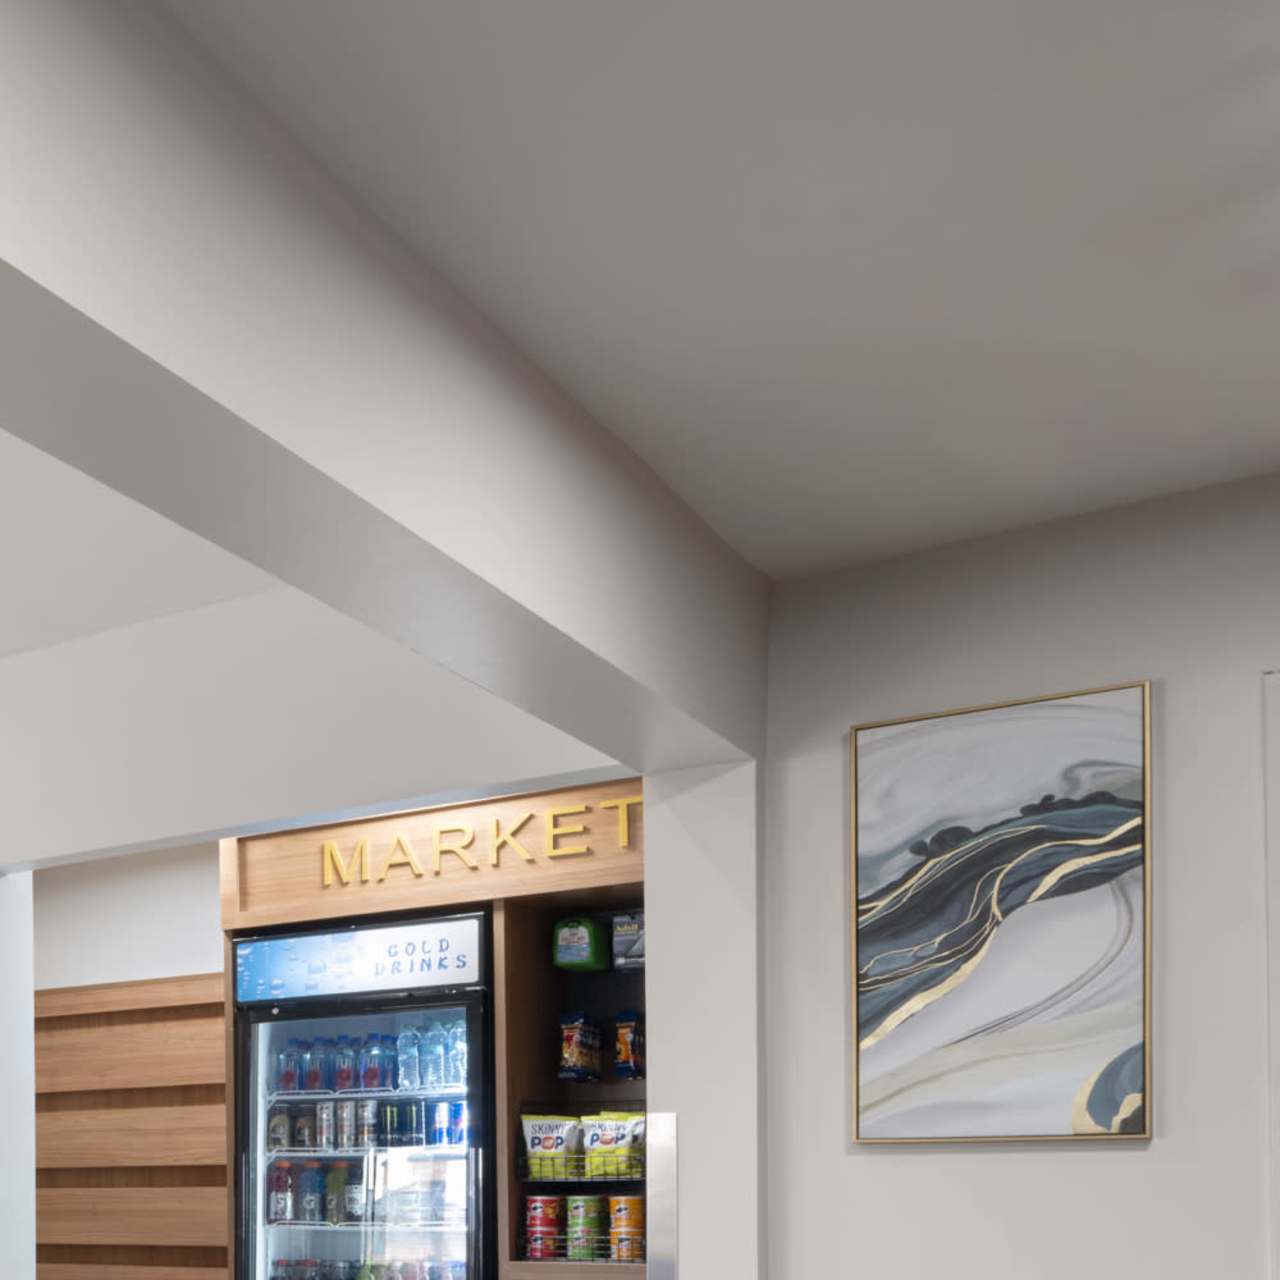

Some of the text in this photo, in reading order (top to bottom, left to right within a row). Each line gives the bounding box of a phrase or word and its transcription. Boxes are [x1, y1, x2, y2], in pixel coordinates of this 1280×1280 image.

[322, 796, 643, 887] MARKET
[386, 938, 450, 958] COLD
[374, 954, 467, 976] DRINKS
[531, 1136, 564, 1149] POP
